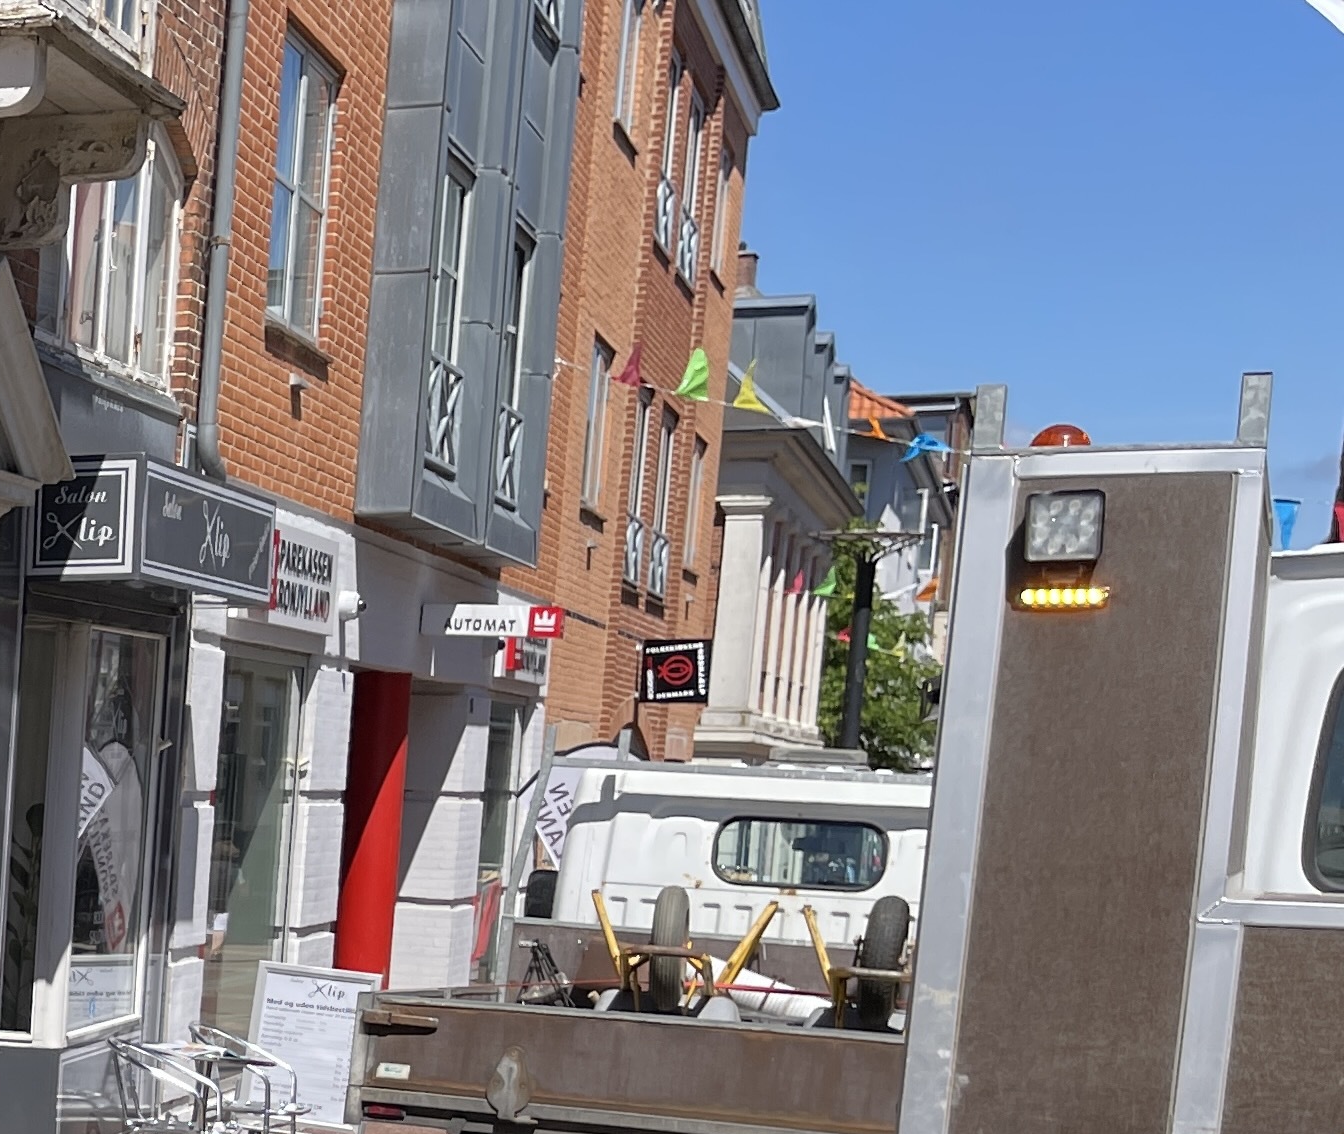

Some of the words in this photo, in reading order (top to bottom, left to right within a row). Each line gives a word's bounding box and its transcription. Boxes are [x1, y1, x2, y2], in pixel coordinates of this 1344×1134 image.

[54, 484, 107, 505] Salon
[279, 539, 334, 584] PAREKASSEN
[444, 617, 517, 632] AUTOMAT
